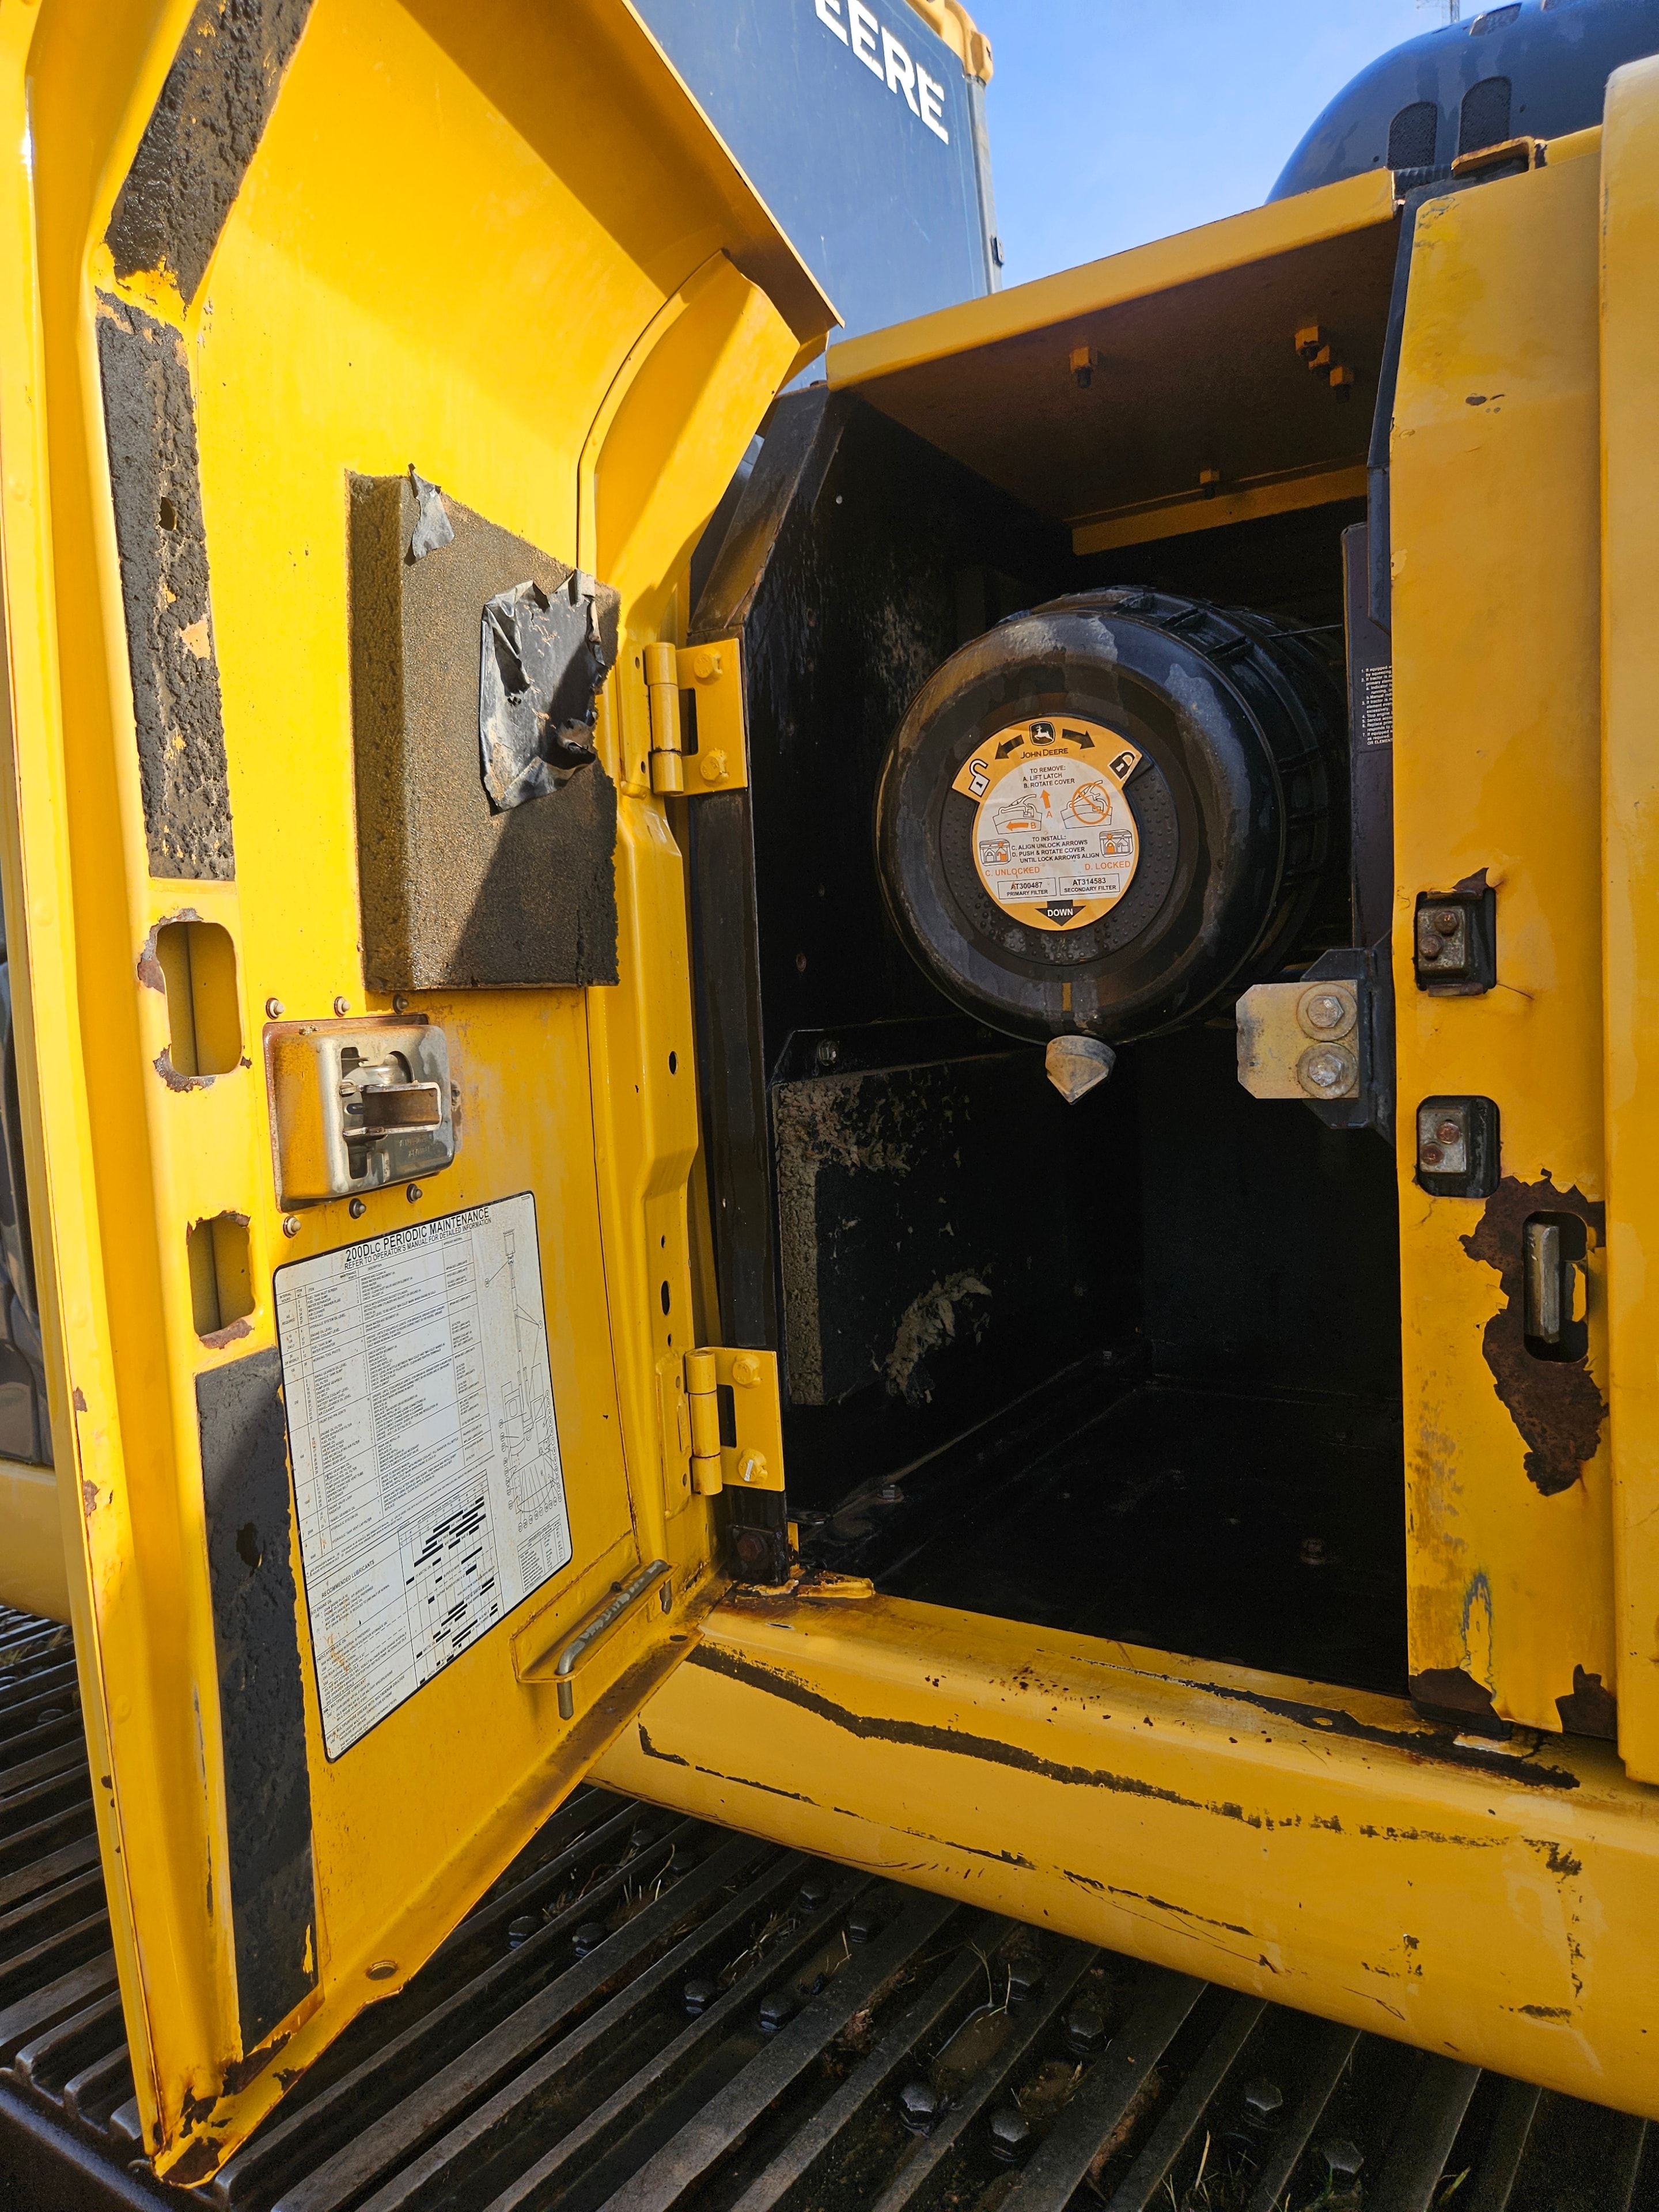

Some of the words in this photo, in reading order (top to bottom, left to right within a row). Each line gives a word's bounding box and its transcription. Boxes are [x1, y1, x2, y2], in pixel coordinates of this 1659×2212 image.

[1021, 751, 1041, 759] JOHN
[1096, 861, 1130, 869] LOCKED
[995, 867, 1040, 876] UNLOCKED
[1047, 908, 1073, 917] DOWN
[345, 1240, 381, 1262] 200DLC
[383, 1225, 427, 1250] PERIODIC
[429, 1206, 489, 1236] MAINTENANCE
[344, 1257, 363, 1270] REFER
[364, 1255, 372, 1264] TO
[376, 1244, 406, 1260] OPERATOR'S
[406, 1237, 428, 1250] MANUAL
[428, 1233, 438, 1243] FOR
[439, 1226, 461, 1239] DETAILED
[462, 1217, 491, 1232] INFORMATION
[321, 1574, 351, 1598] RECOMMENDED
[351, 1559, 374, 1578] LUBRICANTS
